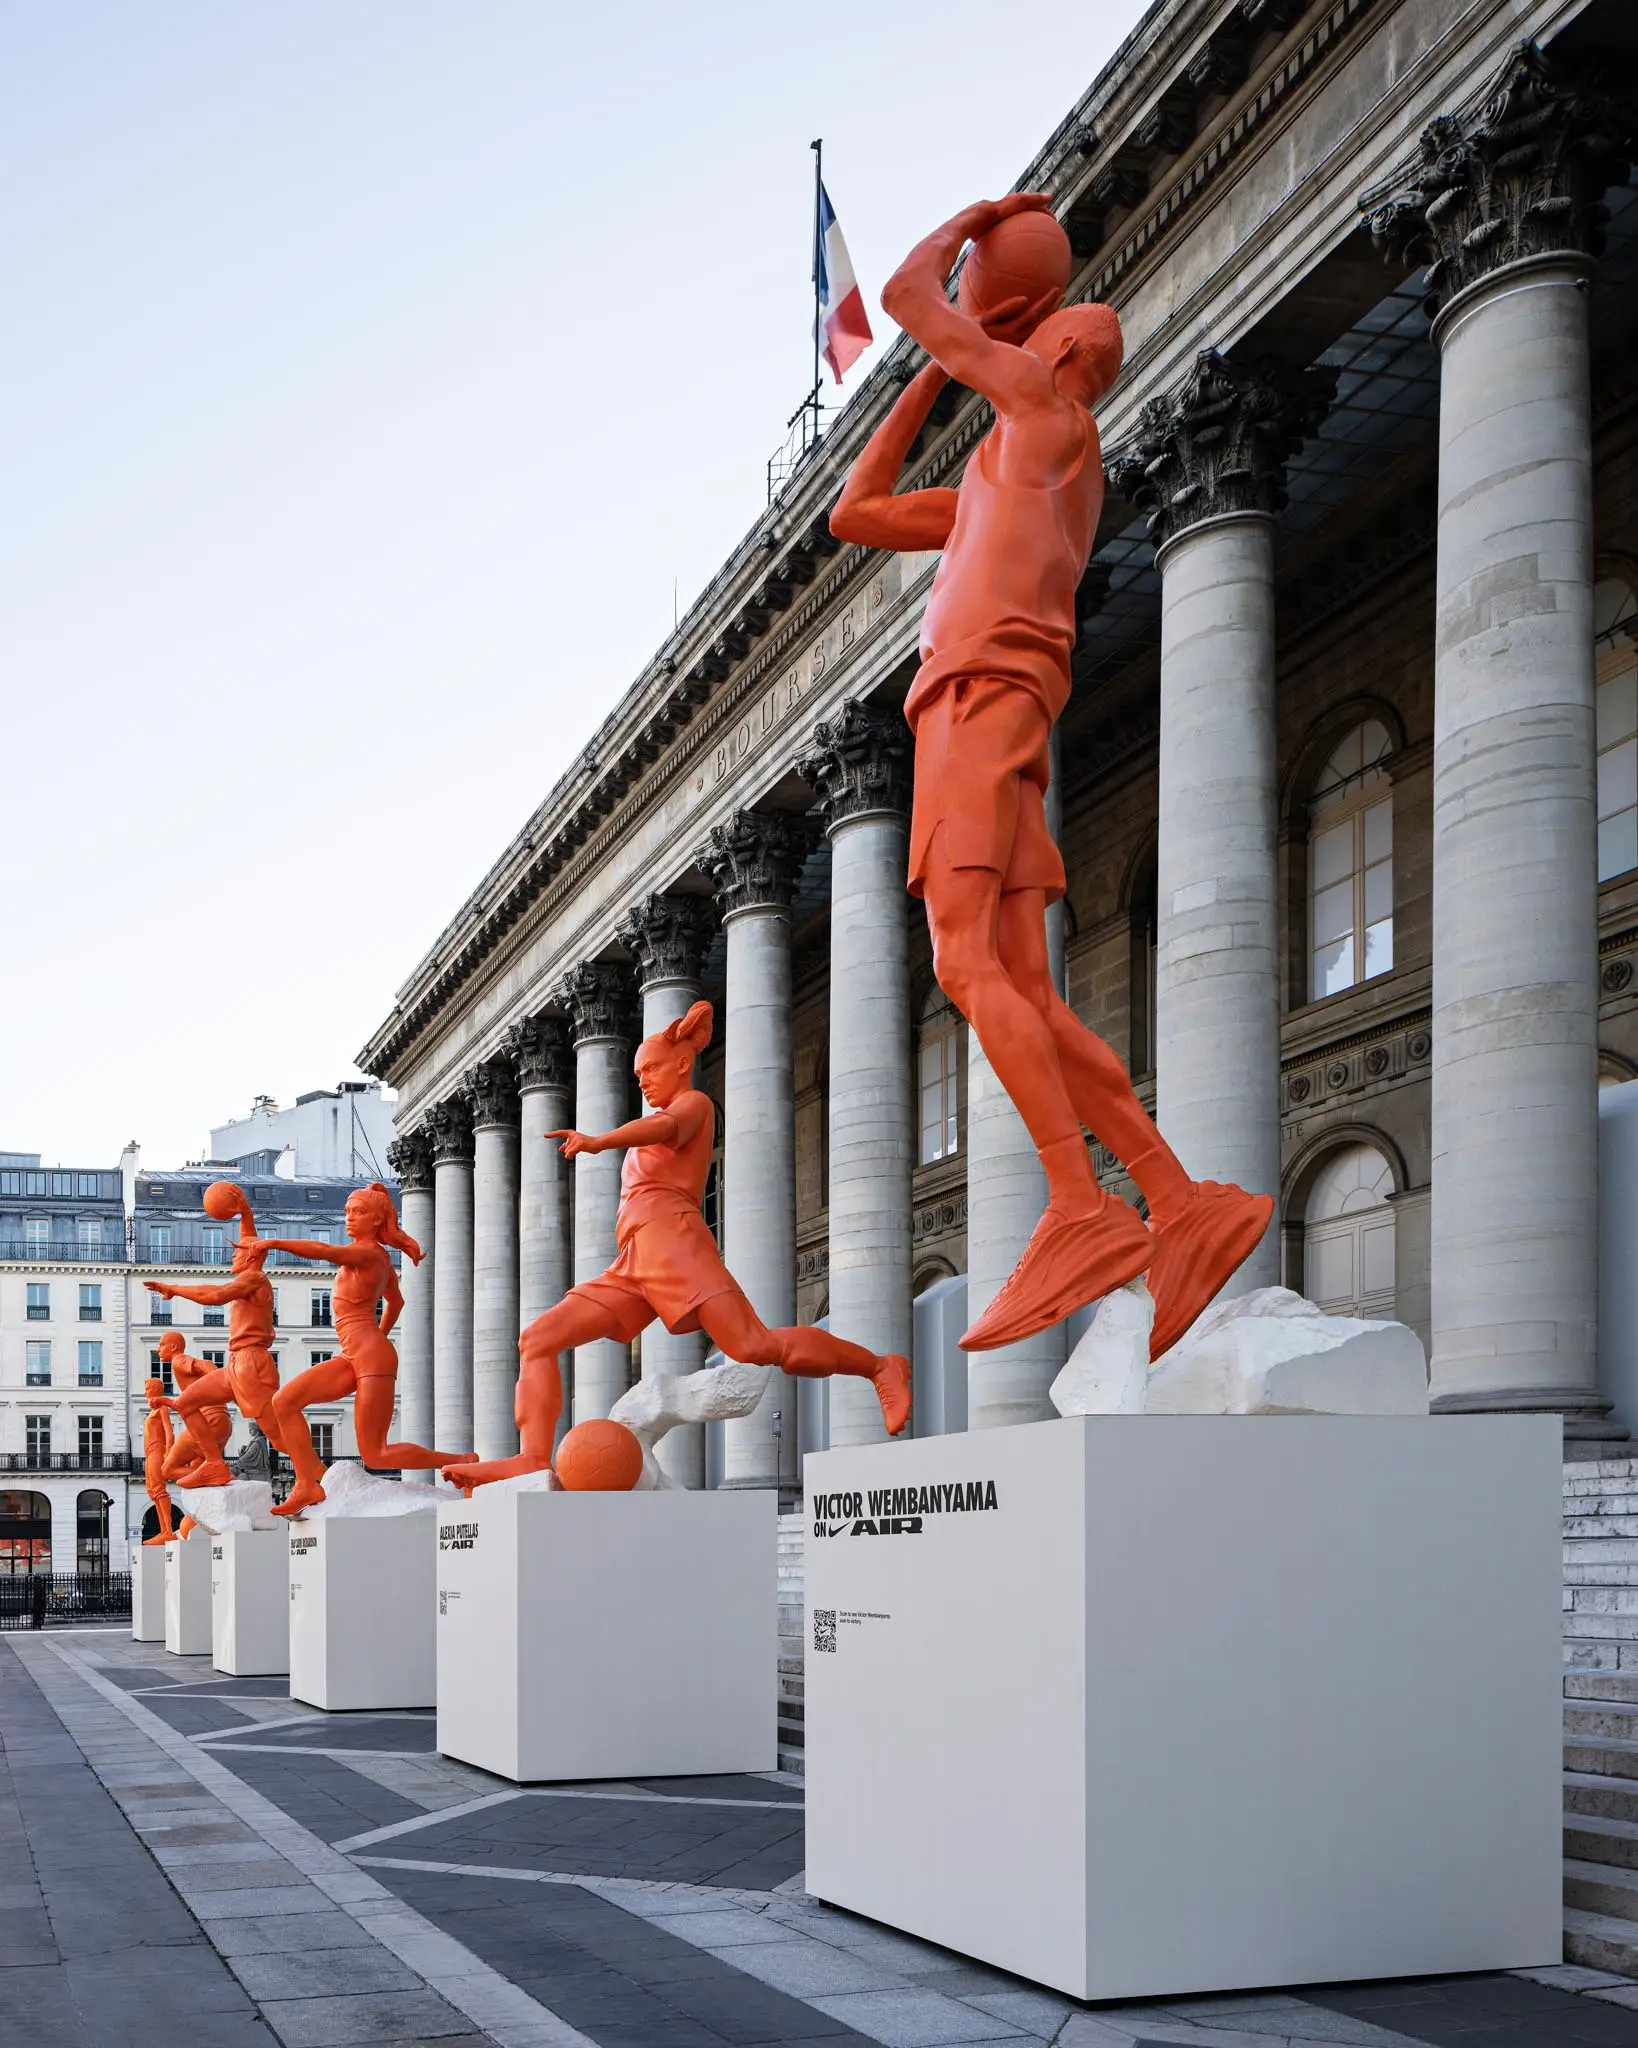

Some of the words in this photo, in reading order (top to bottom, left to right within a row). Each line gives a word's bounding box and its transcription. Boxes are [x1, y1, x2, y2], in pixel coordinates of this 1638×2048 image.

[714, 609, 855, 782] BOURSE
[814, 1492, 863, 1520] VICTOR
[868, 1480, 998, 1517] WEMBANYAMA
[813, 1521, 826, 1538] ON
[850, 1516, 923, 1536] AIR
[451, 1540, 473, 1550] AIR
